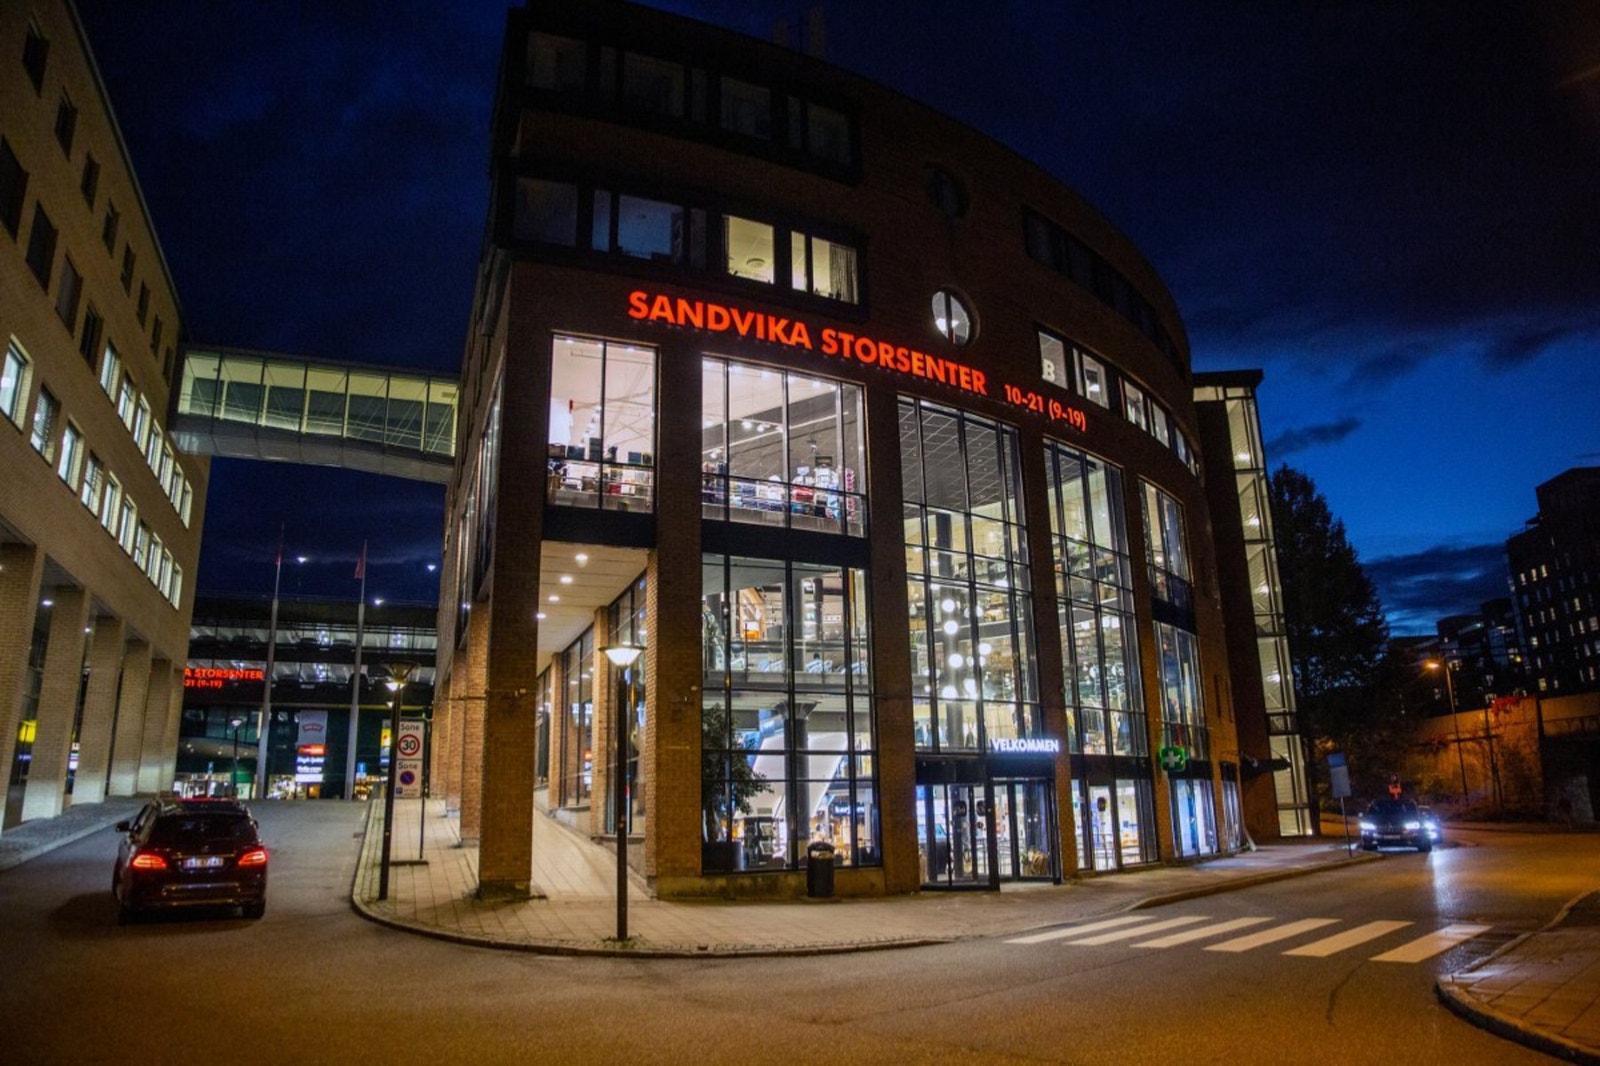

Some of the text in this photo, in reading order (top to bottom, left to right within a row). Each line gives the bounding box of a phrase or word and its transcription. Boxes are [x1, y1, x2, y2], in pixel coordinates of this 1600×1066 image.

[628, 290, 987, 395] SANDVIKA STORSENTER
[1004, 384, 1086, 432] 10-21 (9-19)
[194, 668, 263, 680] STORSENTER
[197, 680, 222, 688] (9-19)
[401, 723, 419, 731] Sone
[402, 740, 416, 750] 30
[991, 738, 1060, 752] VELKOMMEN
[399, 761, 418, 769] Sone
